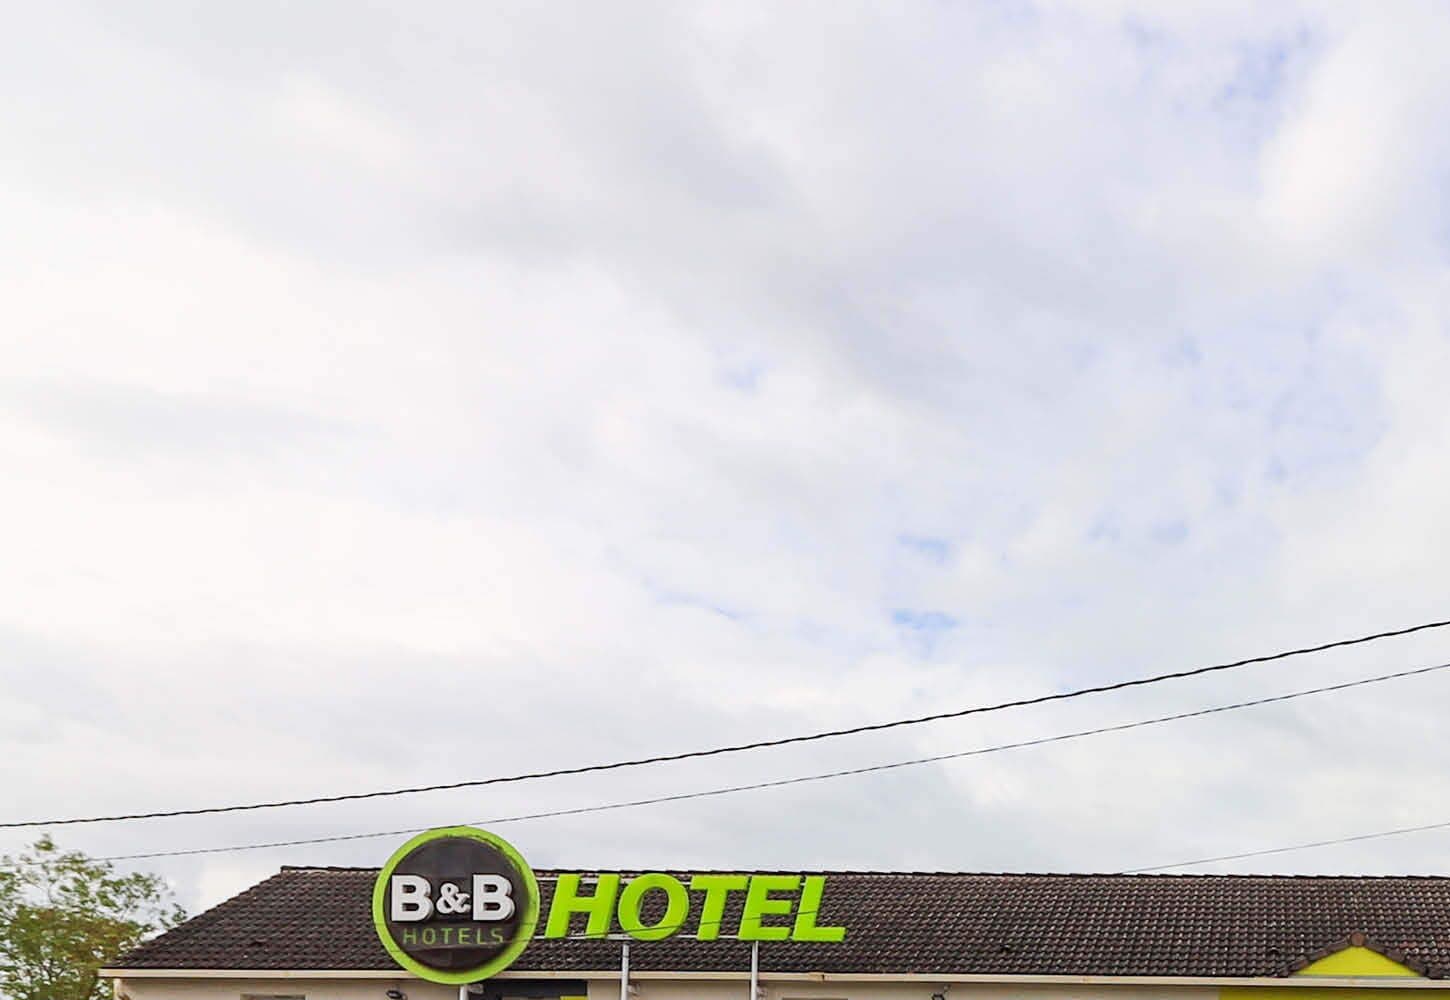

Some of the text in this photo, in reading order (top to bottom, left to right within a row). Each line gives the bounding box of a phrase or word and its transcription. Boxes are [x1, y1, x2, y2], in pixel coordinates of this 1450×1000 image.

[390, 874, 516, 922] B&B
[544, 873, 846, 942] HOTEL
[402, 927, 504, 945] HOTELS
